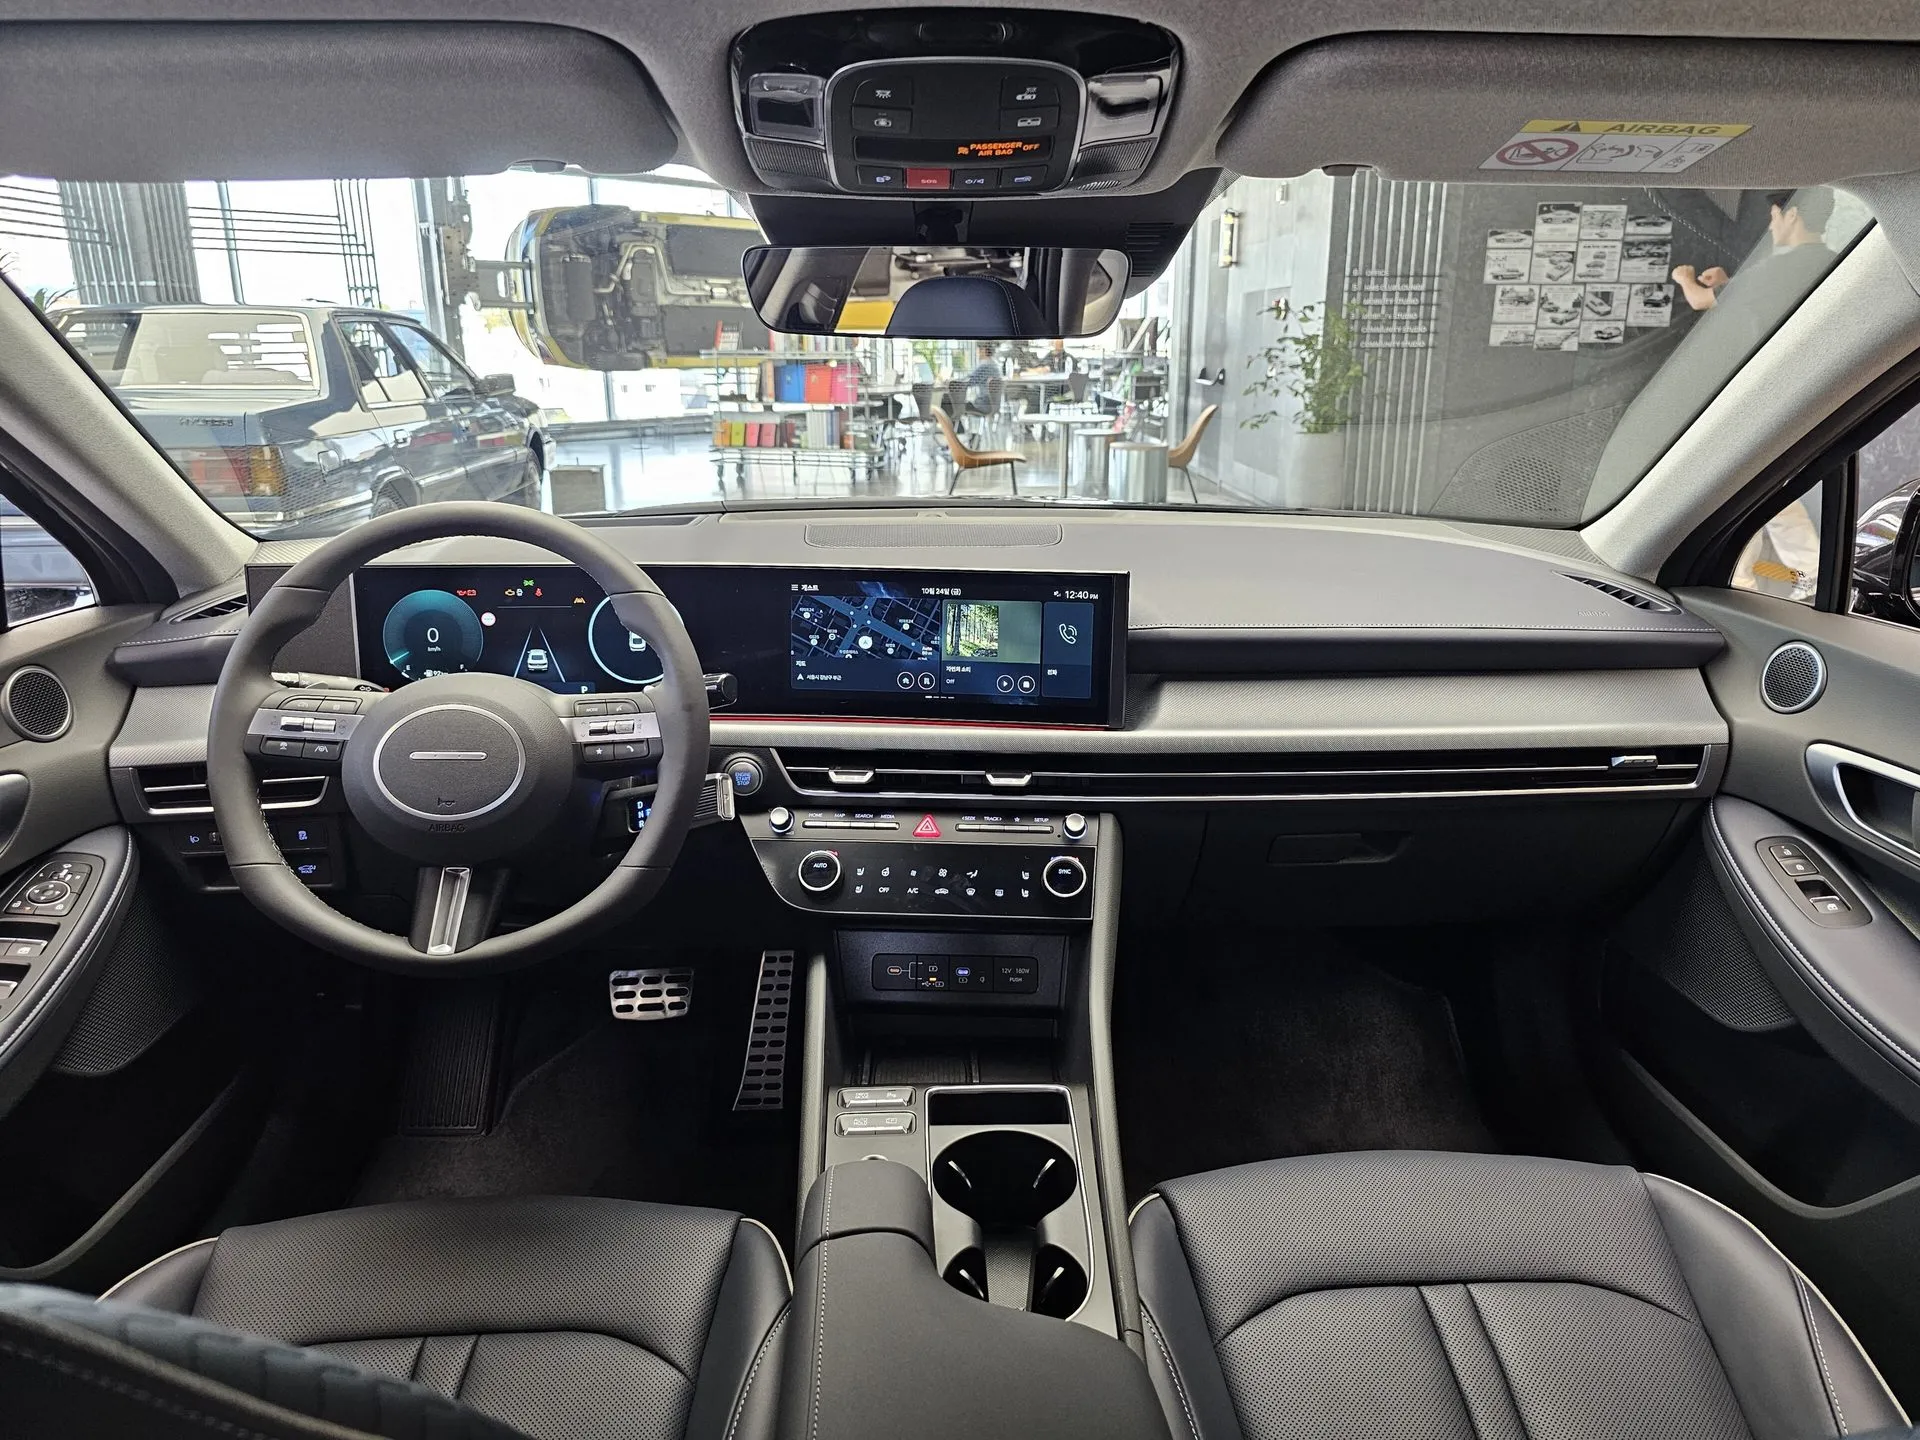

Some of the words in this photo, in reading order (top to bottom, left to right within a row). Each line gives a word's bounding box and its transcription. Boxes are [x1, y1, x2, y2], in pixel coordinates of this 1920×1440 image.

[1604, 123, 1722, 135] AIRBAG
[969, 141, 1022, 150] PASSENGER
[1022, 143, 1040, 151] OFF
[935, 588, 950, 596] 24일
[950, 588, 962, 596] (금)
[1065, 590, 1089, 600] 12:40
[427, 627, 440, 643] 0
[580, 685, 589, 694] P
[429, 823, 466, 832] AIRBAG
[638, 820, 644, 828] R
